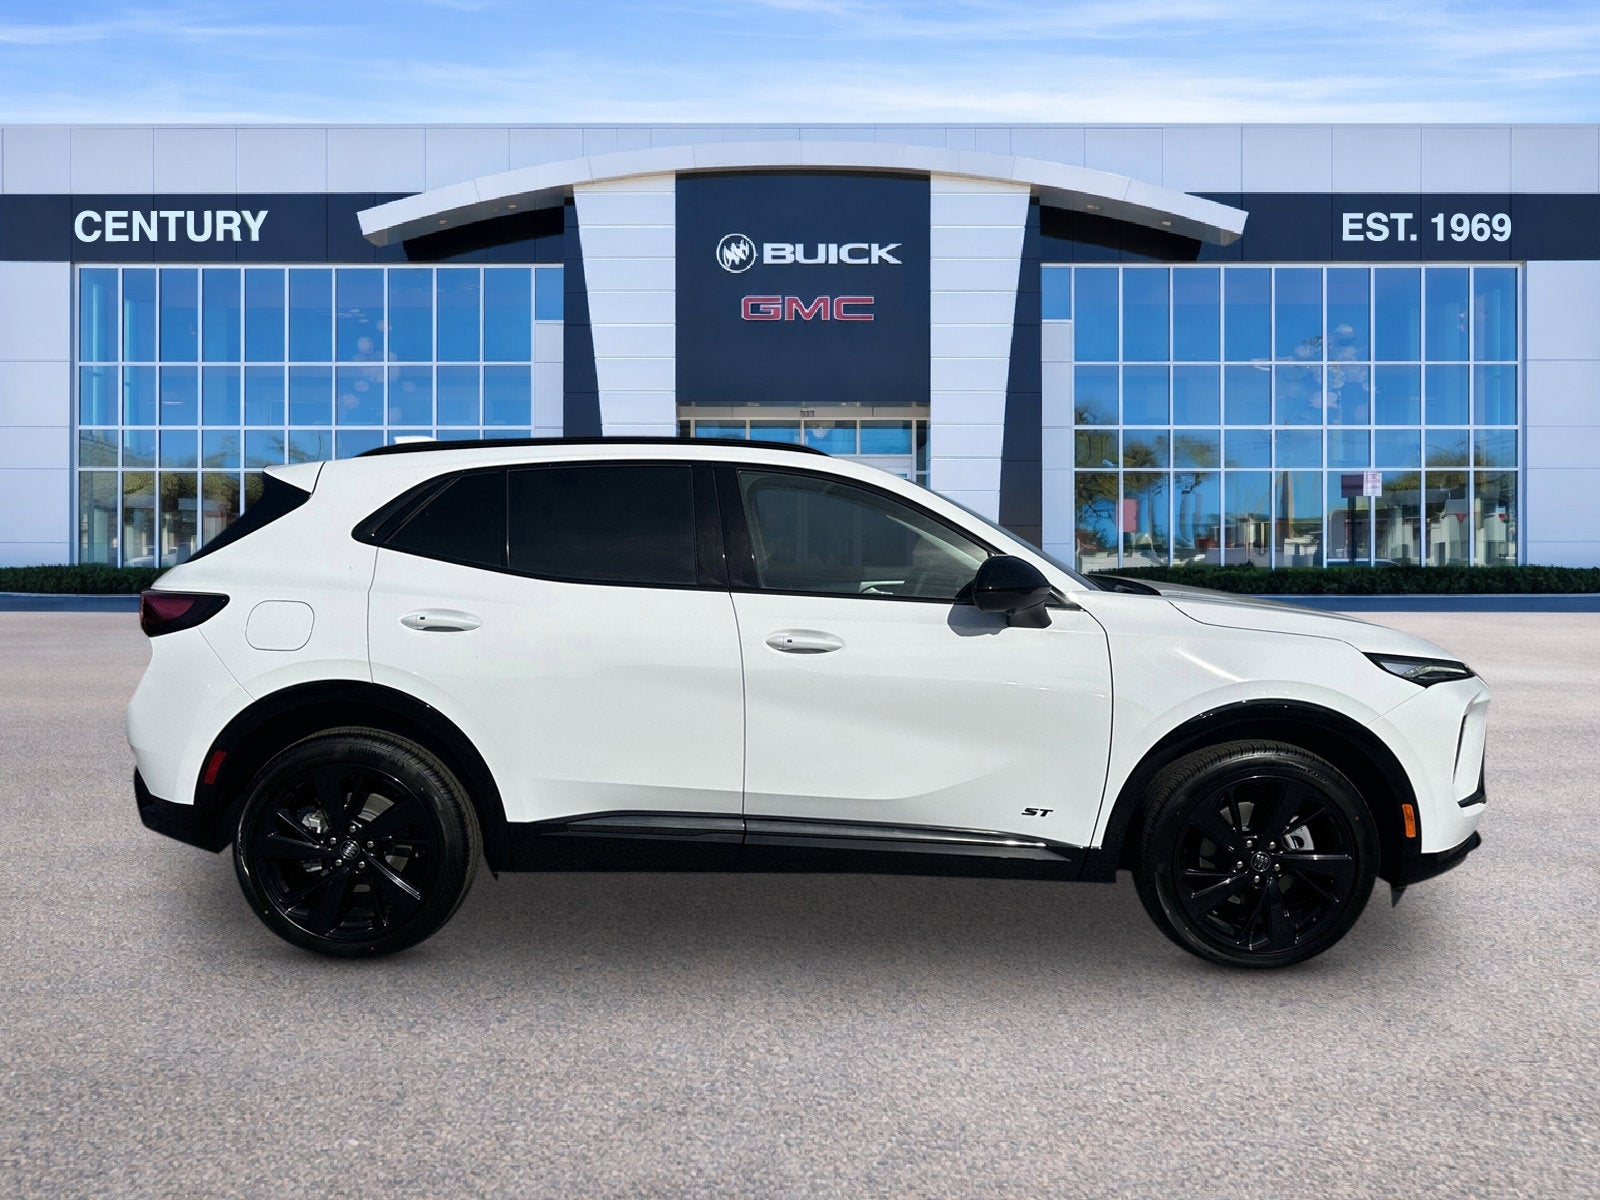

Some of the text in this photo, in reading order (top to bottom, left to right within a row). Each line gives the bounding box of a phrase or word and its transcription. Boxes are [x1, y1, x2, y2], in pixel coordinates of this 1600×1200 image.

[74, 210, 269, 243] CENTURY
[1342, 212, 1512, 242] EST. 1969
[762, 243, 902, 265] BUICK
[741, 295, 875, 321] GMC
[1021, 807, 1054, 817] ST
